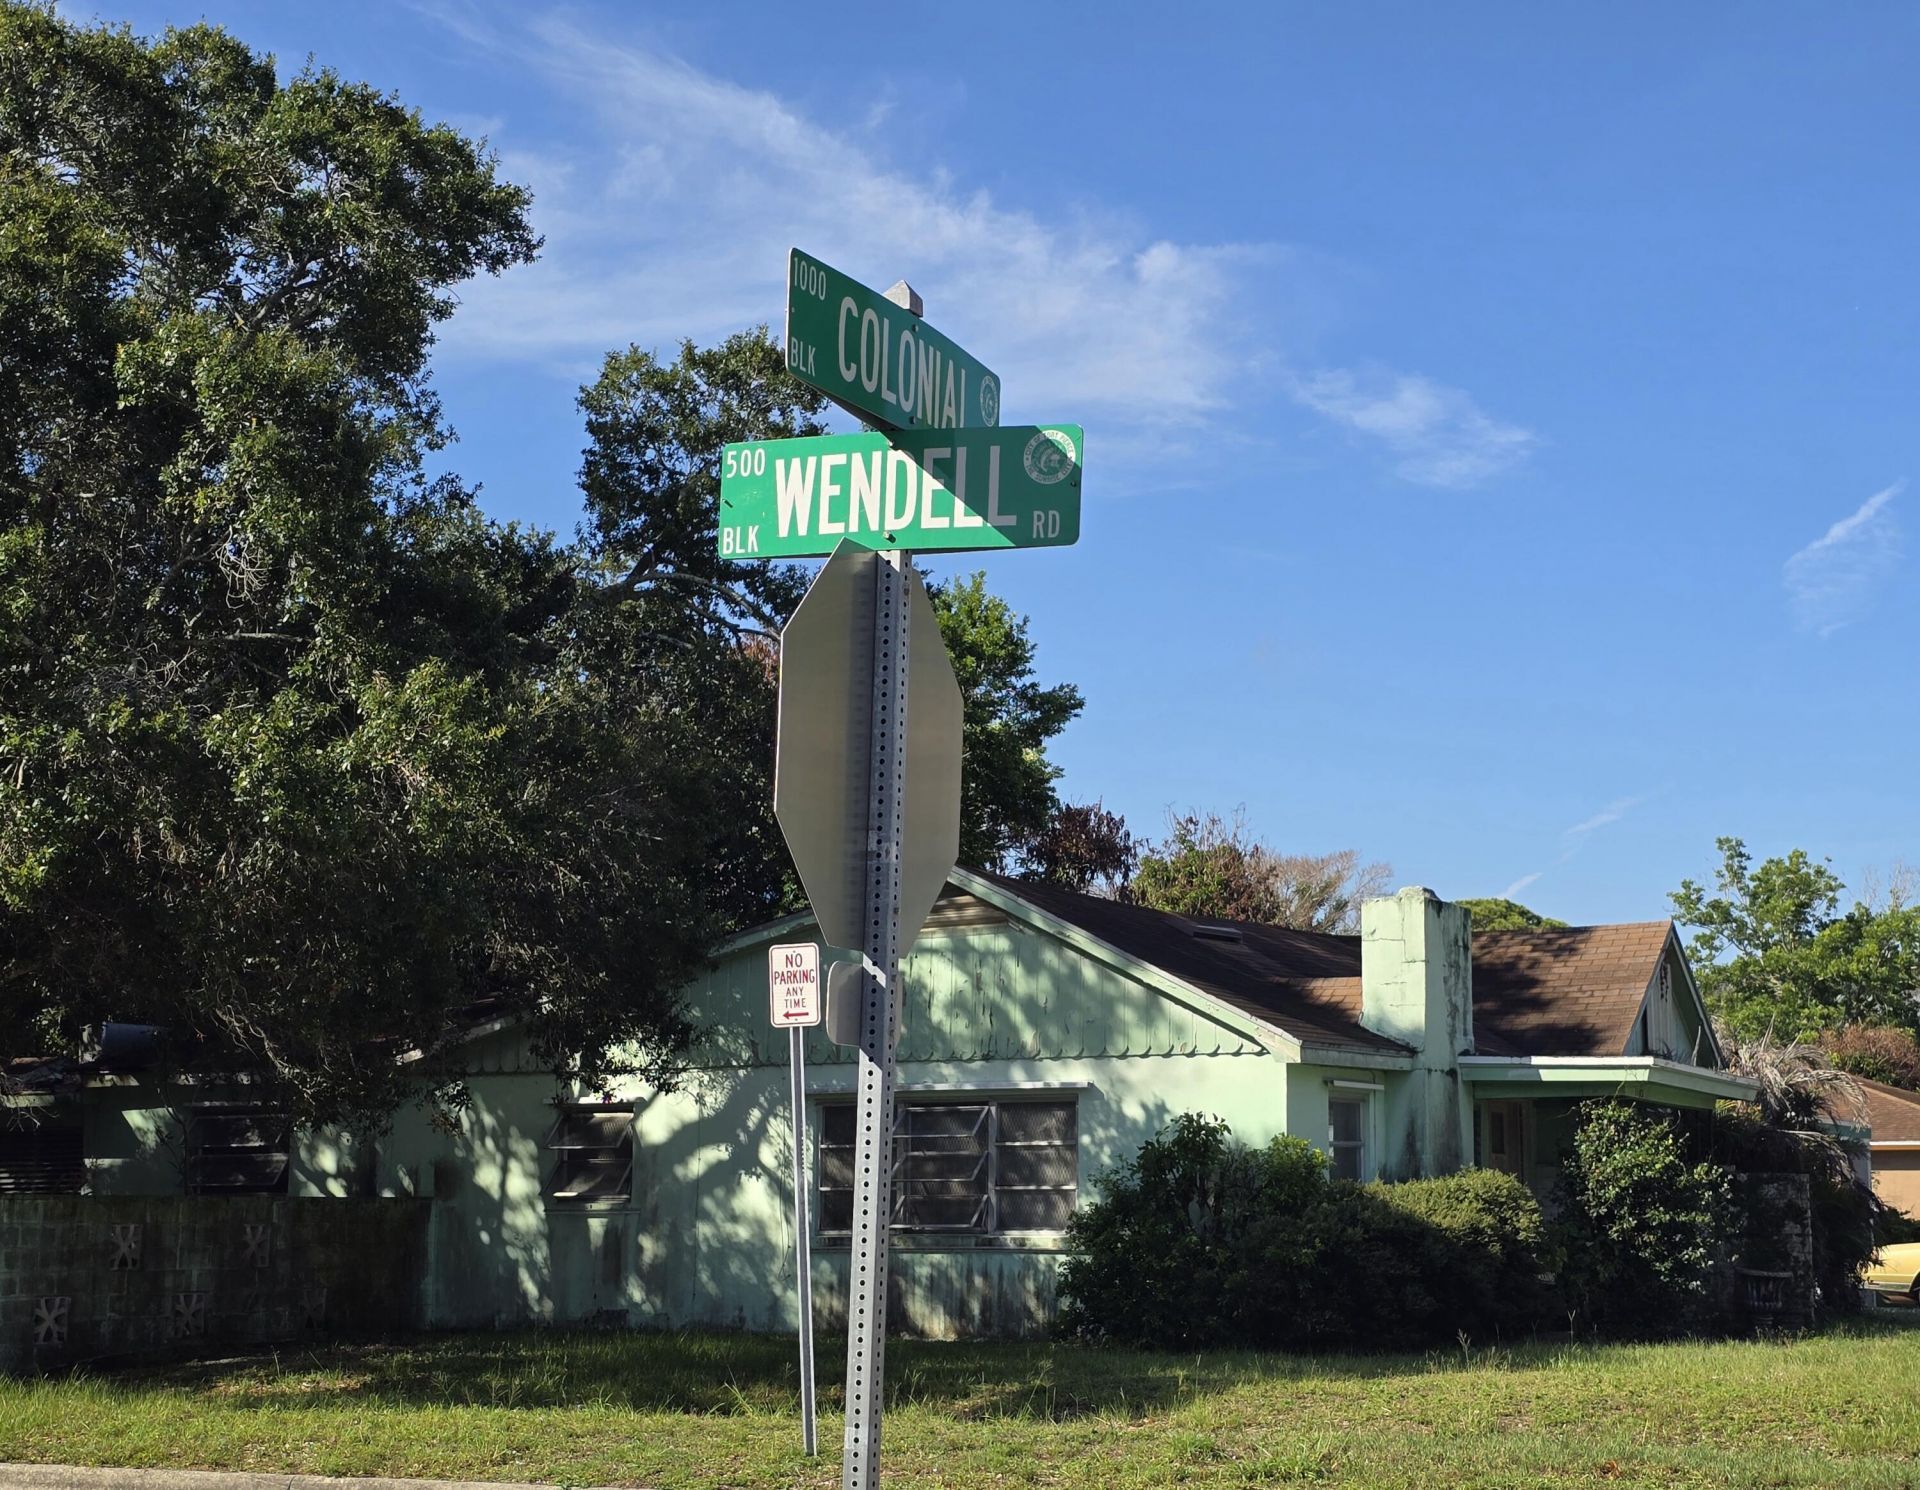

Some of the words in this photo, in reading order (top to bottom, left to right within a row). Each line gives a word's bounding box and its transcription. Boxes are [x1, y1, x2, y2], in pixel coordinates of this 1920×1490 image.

[794, 257, 826, 300] 1000
[791, 337, 816, 377] BLK
[726, 448, 766, 478] 500
[775, 445, 1017, 538] WENDELL
[1032, 510, 1060, 539] RD
[723, 525, 759, 555] BLK
[785, 953, 803, 968] NO
[774, 969, 815, 985] PARKING
[786, 986, 804, 997] ANY
[784, 998, 806, 1008] TIME
